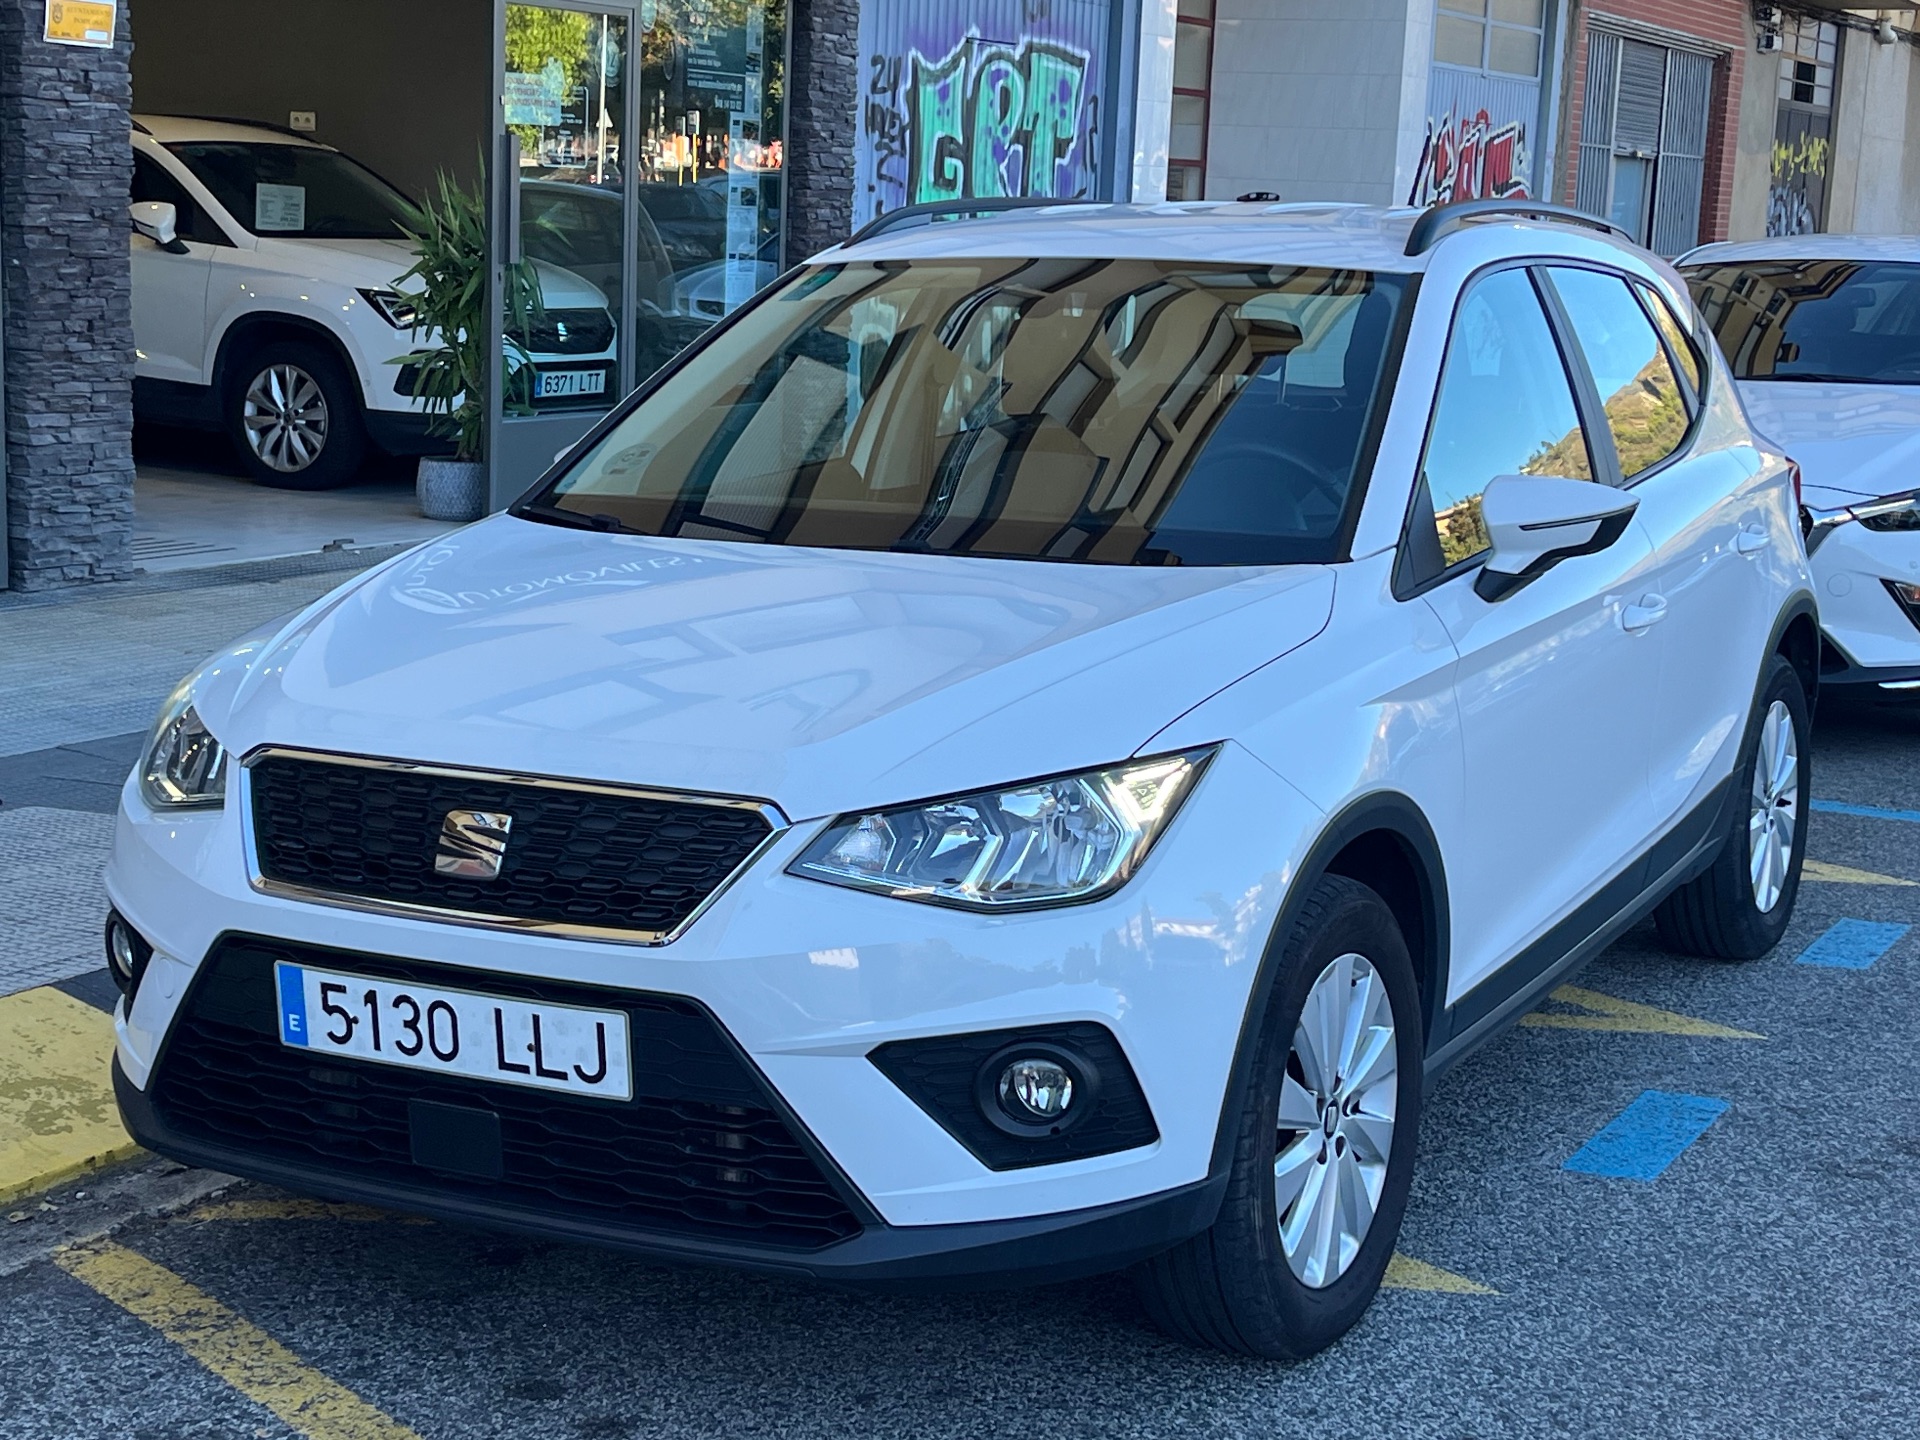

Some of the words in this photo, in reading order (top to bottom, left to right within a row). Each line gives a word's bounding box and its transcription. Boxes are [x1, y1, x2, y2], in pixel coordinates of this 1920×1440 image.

[544, 374, 574, 394] 6371
[579, 372, 601, 392] LTT
[288, 1013, 301, 1032] E
[320, 981, 460, 1062] 5130
[494, 1007, 607, 1084] LLJ
